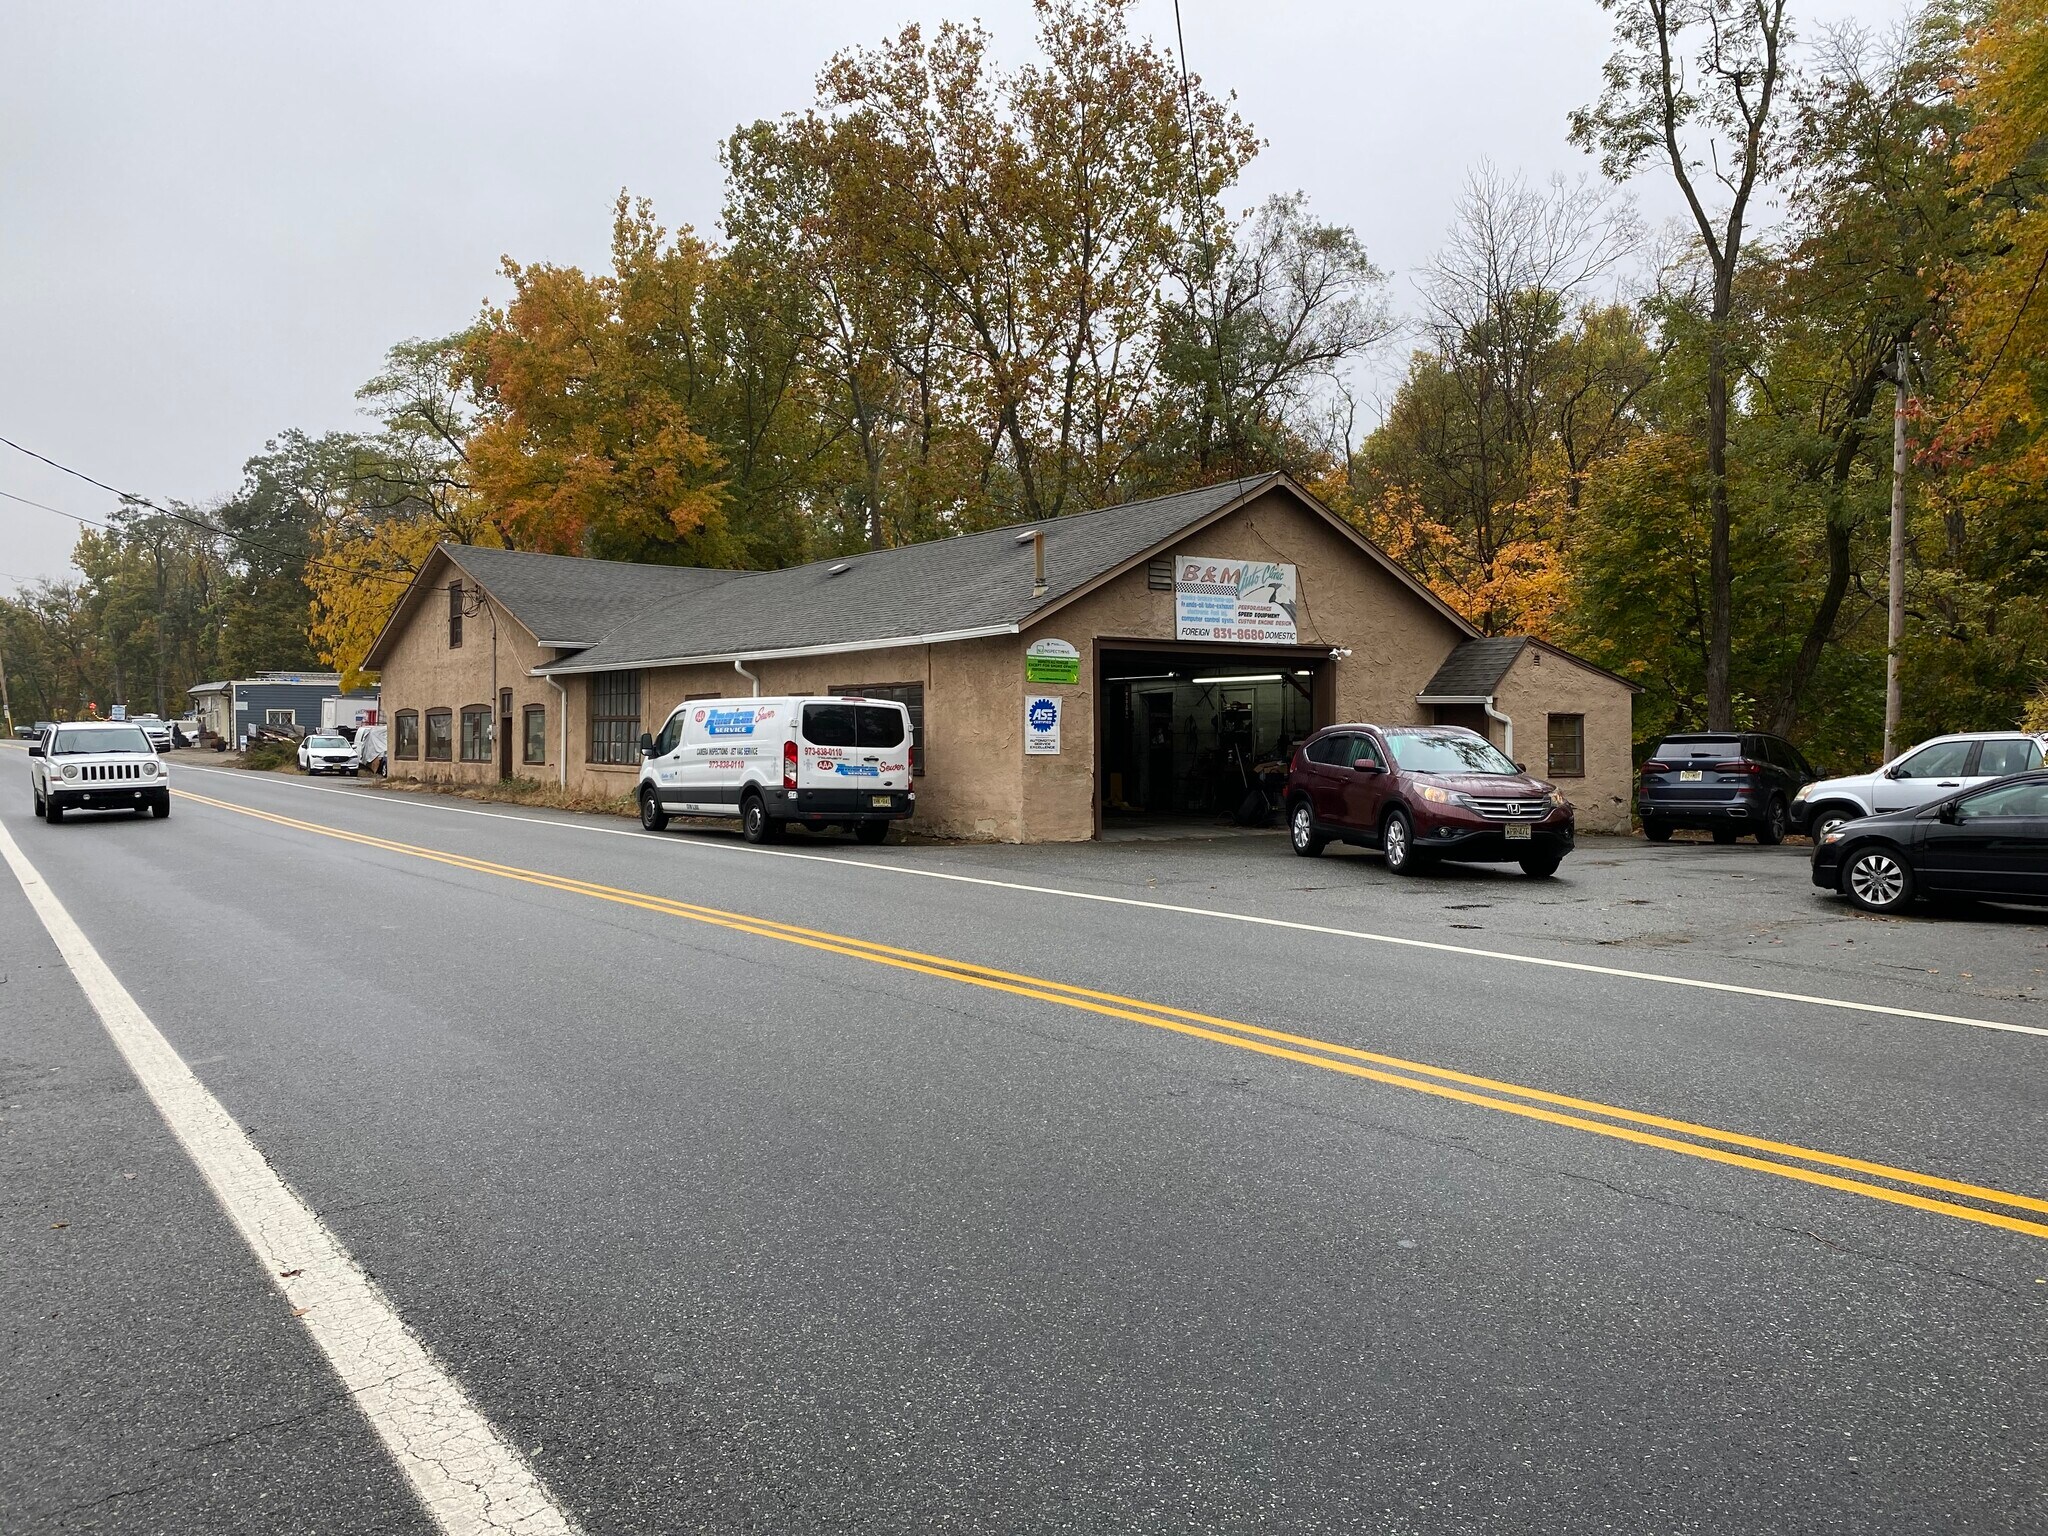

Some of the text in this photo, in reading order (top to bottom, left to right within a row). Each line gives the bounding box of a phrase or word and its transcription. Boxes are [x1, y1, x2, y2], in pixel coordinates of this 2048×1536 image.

[1182, 564, 1200, 581] B
[1201, 566, 1217, 583] &
[1220, 567, 1240, 584] M
[1236, 564, 1262, 600] Auto
[1262, 565, 1284, 584] Clinic
[1181, 627, 1296, 641] FOREIGN 831-8680 DOMESTIC
[704, 708, 754, 728] American
[755, 706, 775, 723] Sewer
[1032, 708, 1053, 721] ASE
[804, 747, 843, 757] 973-838-0110
[818, 761, 833, 770] AAA
[880, 761, 905, 773] Sewer
